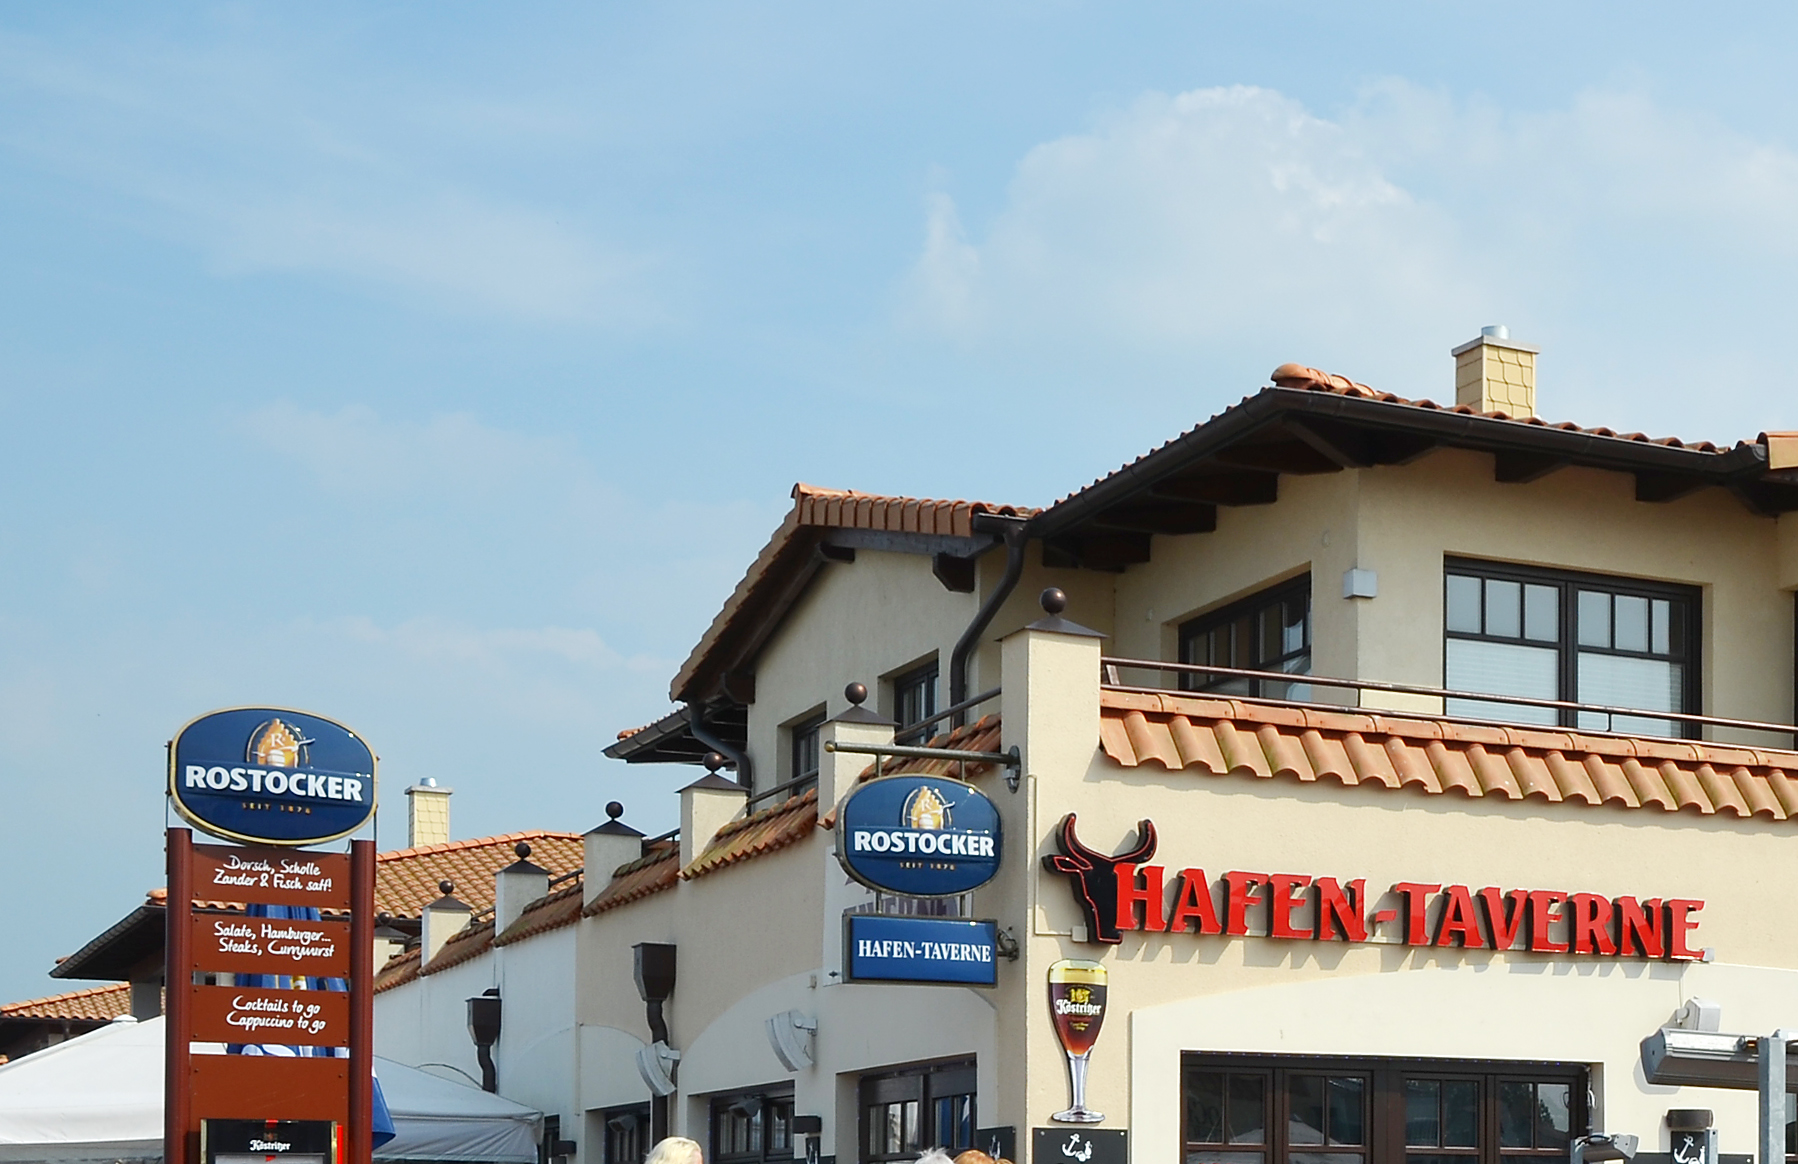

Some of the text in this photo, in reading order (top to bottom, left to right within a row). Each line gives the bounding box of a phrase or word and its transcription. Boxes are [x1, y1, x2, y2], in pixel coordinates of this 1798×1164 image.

[185, 765, 363, 801] ROSTOCKER
[242, 802, 270, 810] SEIT
[854, 831, 995, 857] ROSTOCKER
[222, 854, 322, 876] Dorsch, Scholle
[213, 868, 332, 893] Zander & Fisch satt!
[1114, 862, 1706, 961] HAFEN-TAVERNE
[213, 920, 332, 946] Salate, Hamburger...
[218, 937, 335, 961] Steaks, Currywurst
[857, 939, 992, 963] HAFEN-TAVERNE
[232, 995, 321, 1018] Cocktails to go
[226, 1010, 326, 1034] Cappuccino to go
